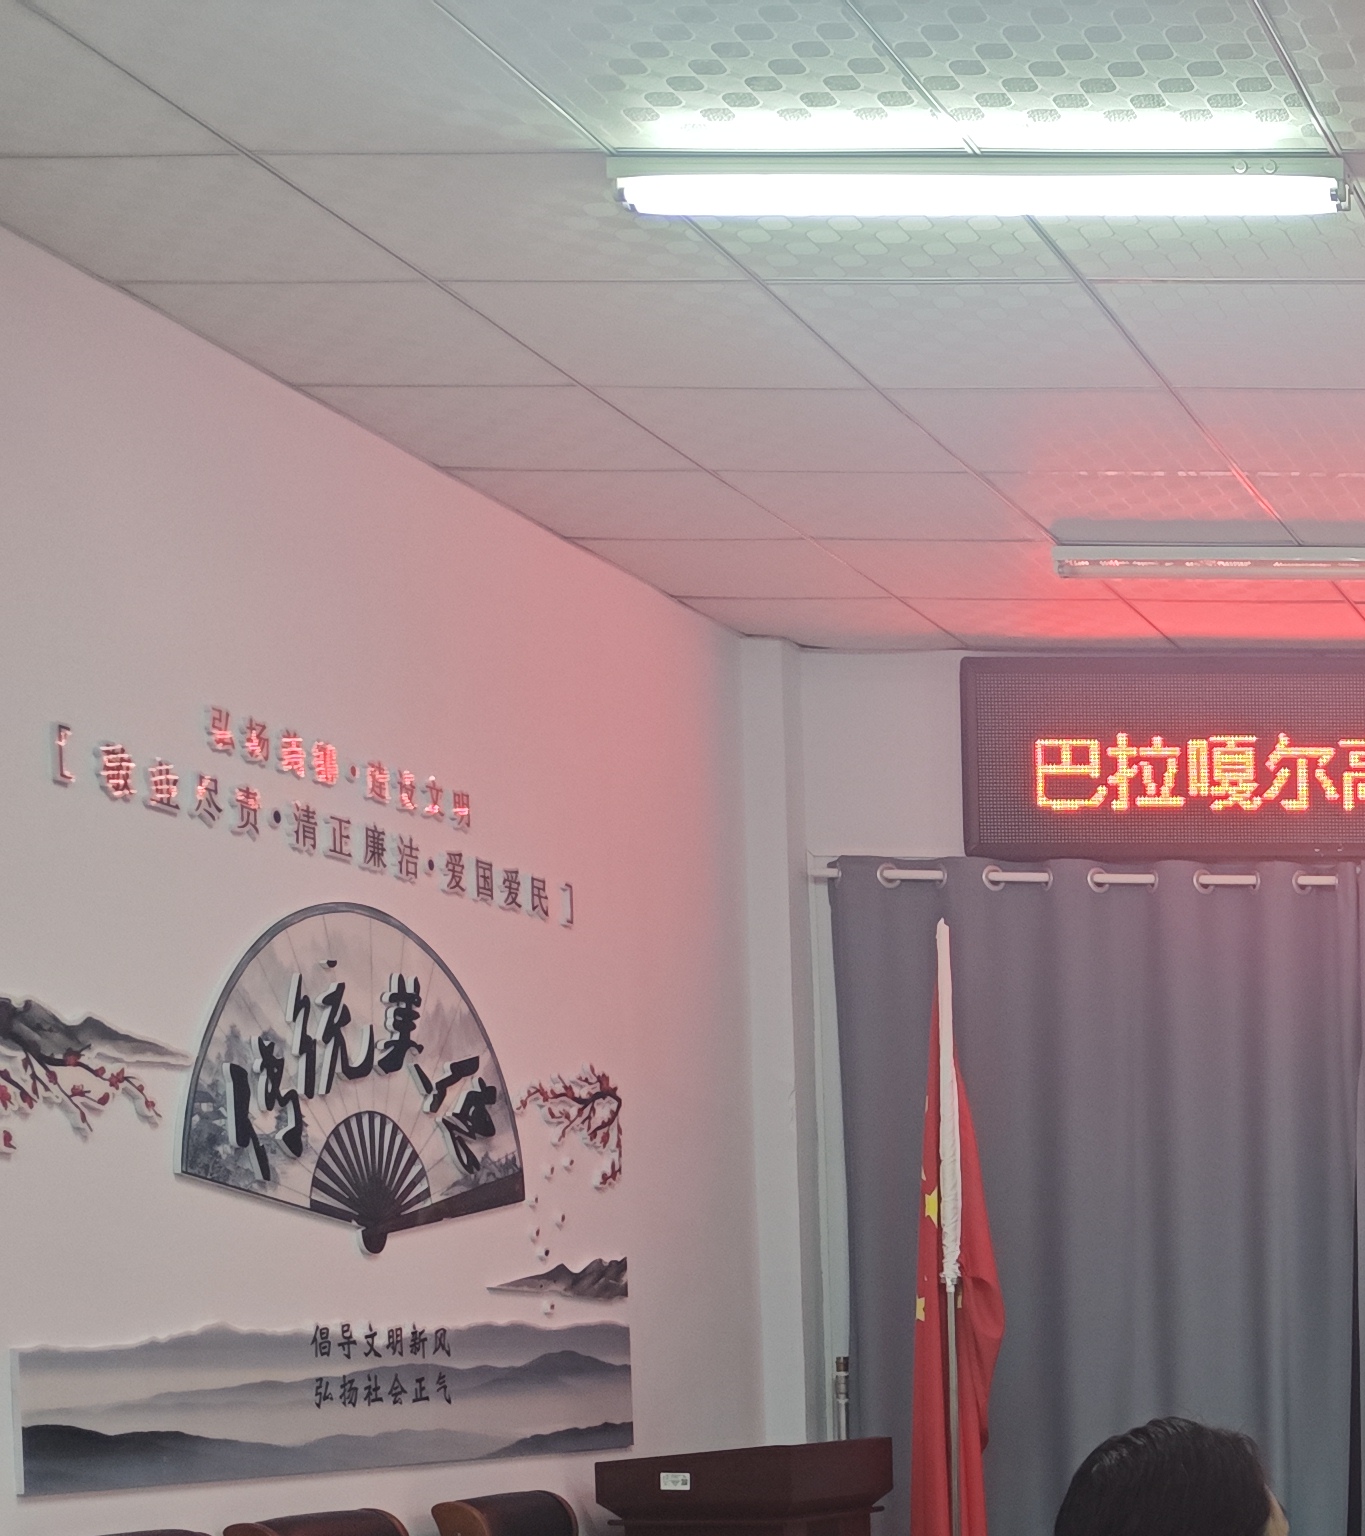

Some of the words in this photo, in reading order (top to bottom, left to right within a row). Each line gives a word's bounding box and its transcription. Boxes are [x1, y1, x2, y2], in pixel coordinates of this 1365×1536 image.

[310, 1322, 451, 1359] 倡导文明新风
[314, 1371, 452, 1409] 弘扬社会正气
